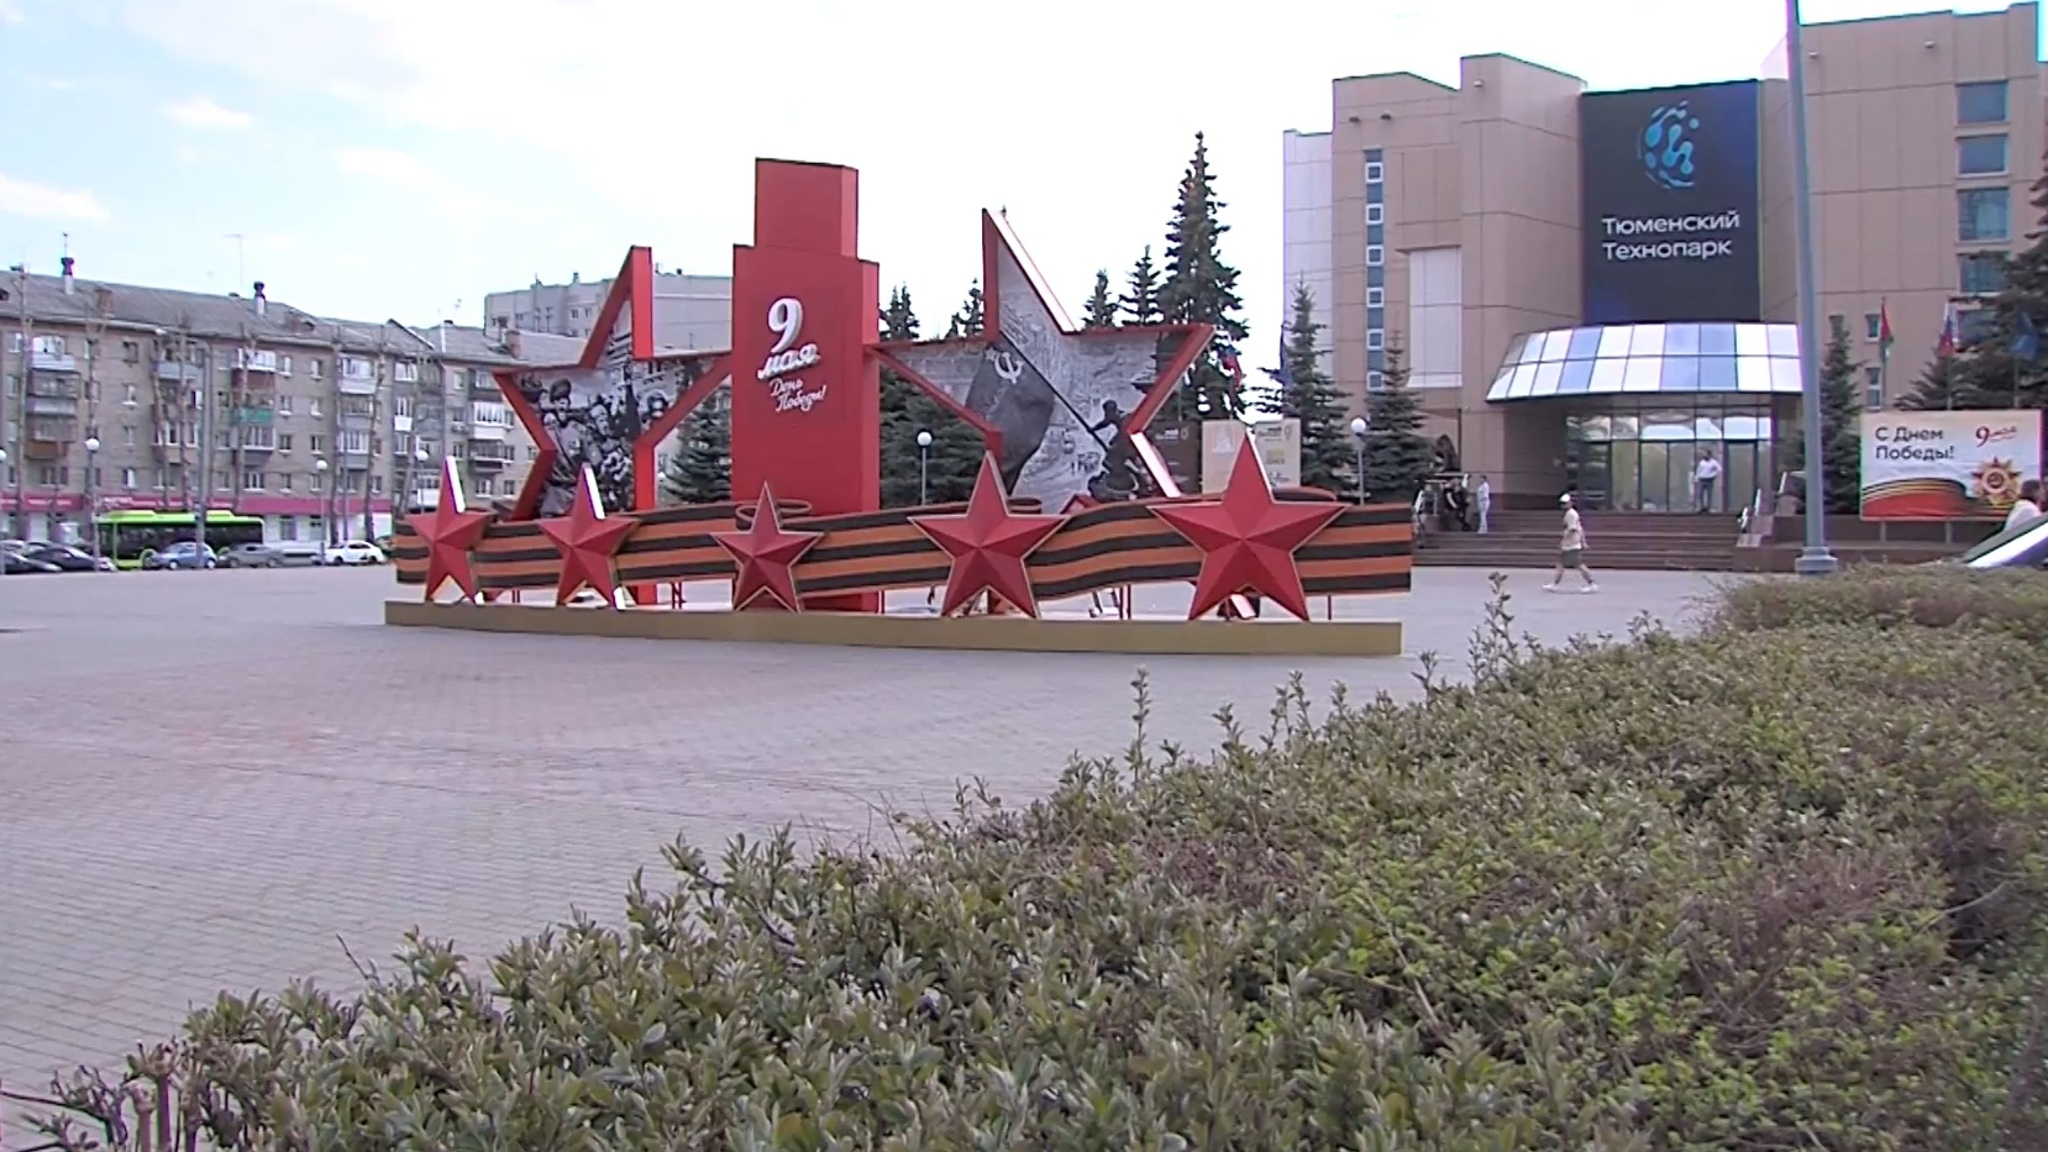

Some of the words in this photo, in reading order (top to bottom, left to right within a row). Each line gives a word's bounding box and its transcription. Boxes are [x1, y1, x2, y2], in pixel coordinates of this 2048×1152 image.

[1602, 209, 1740, 235] Тюменский
[1602, 240, 1732, 261] Технопарк
[768, 297, 803, 354] 9
[757, 343, 821, 379] мая
[1874, 426, 1889, 441] С
[1893, 426, 1944, 443] Днем
[1975, 425, 1990, 448] 9
[1875, 445, 1955, 461] Победы!
